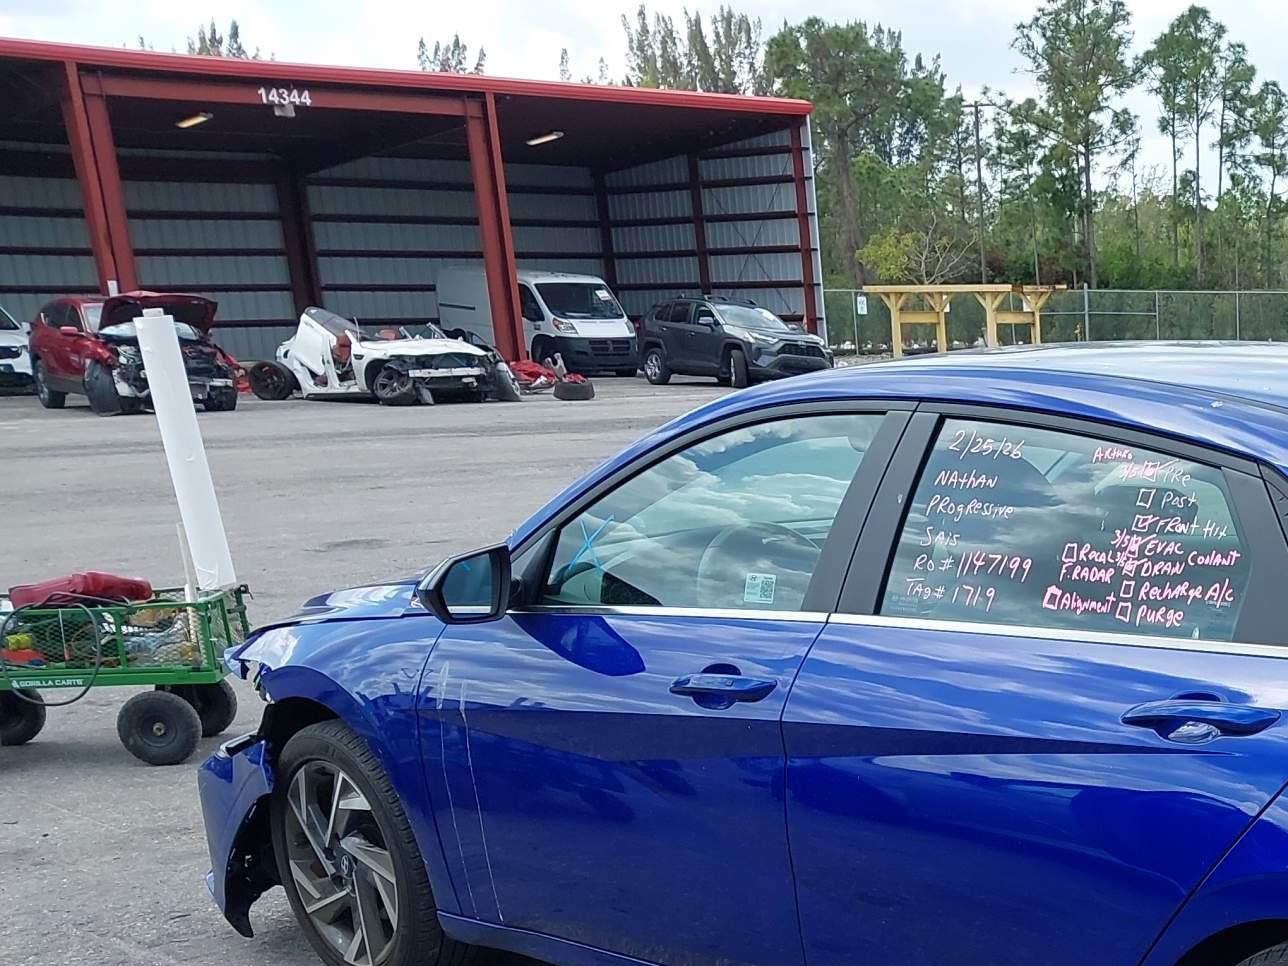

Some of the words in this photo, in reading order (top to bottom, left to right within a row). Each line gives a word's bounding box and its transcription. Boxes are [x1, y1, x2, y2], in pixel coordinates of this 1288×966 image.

[257, 87, 312, 106] 14344
[949, 430, 1025, 460] 2/25/26
[1145, 539, 1184, 556] EVAC
[951, 586, 996, 612] 1719
